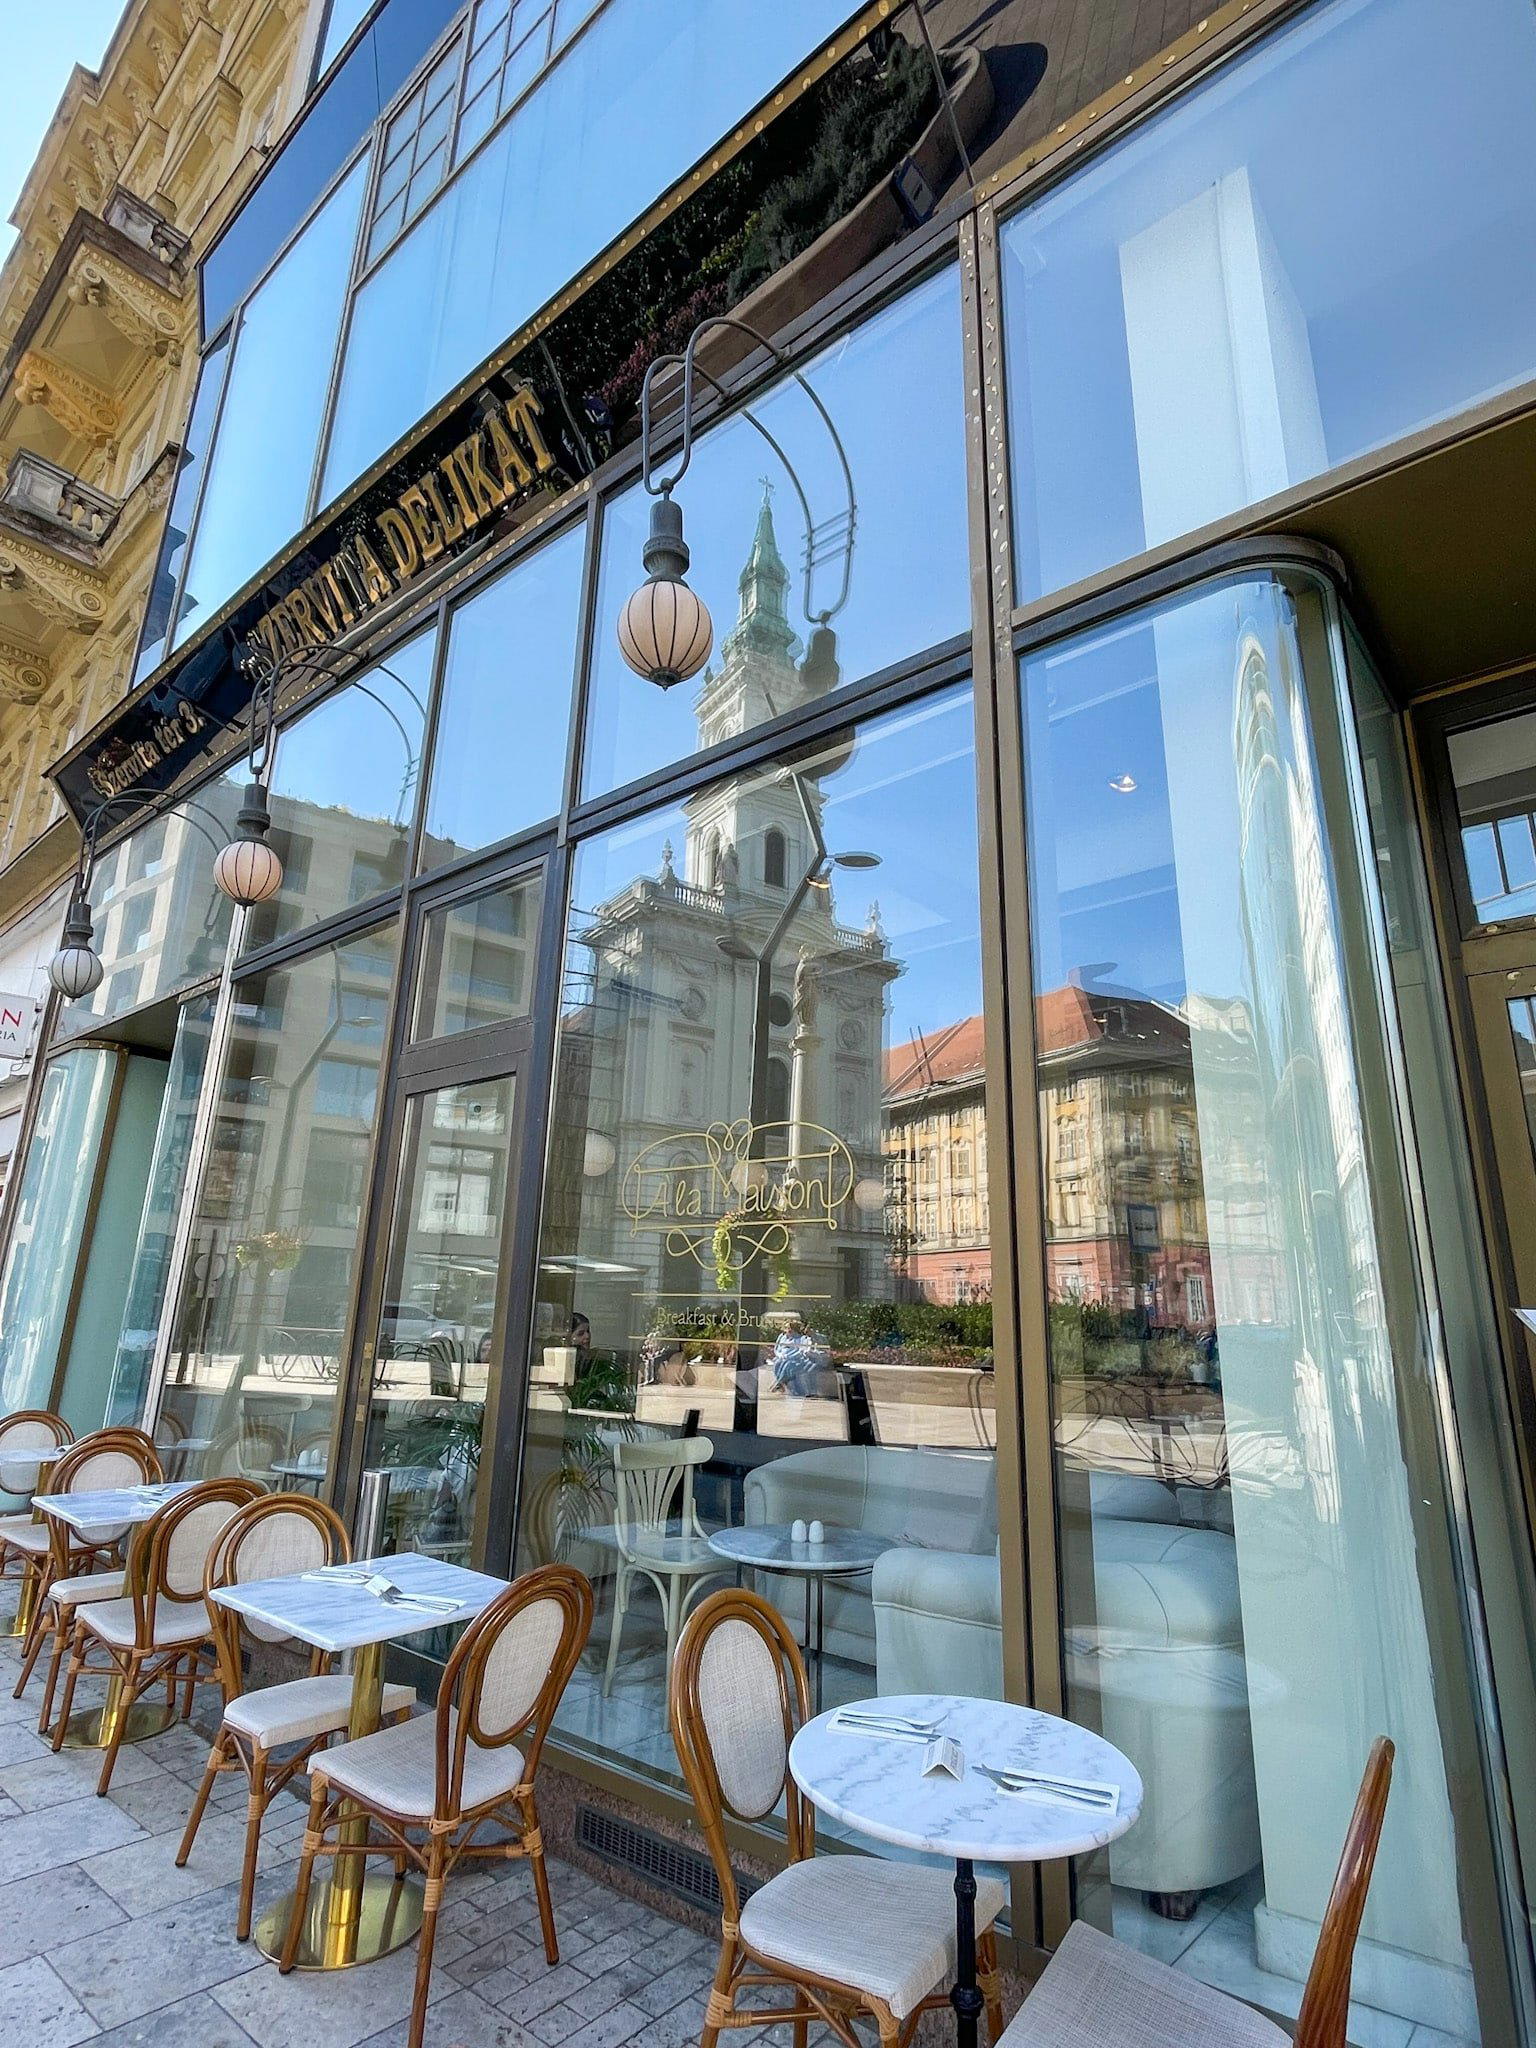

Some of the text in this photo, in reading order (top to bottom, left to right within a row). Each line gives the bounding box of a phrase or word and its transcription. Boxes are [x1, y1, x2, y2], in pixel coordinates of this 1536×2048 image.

[241, 388, 555, 686] SZERVITA DELIKAT
[88, 700, 206, 798] Szervita tér 3.
[706, 1119, 832, 1214] Maison
[656, 1306, 786, 1328] Breakfast & Bru
